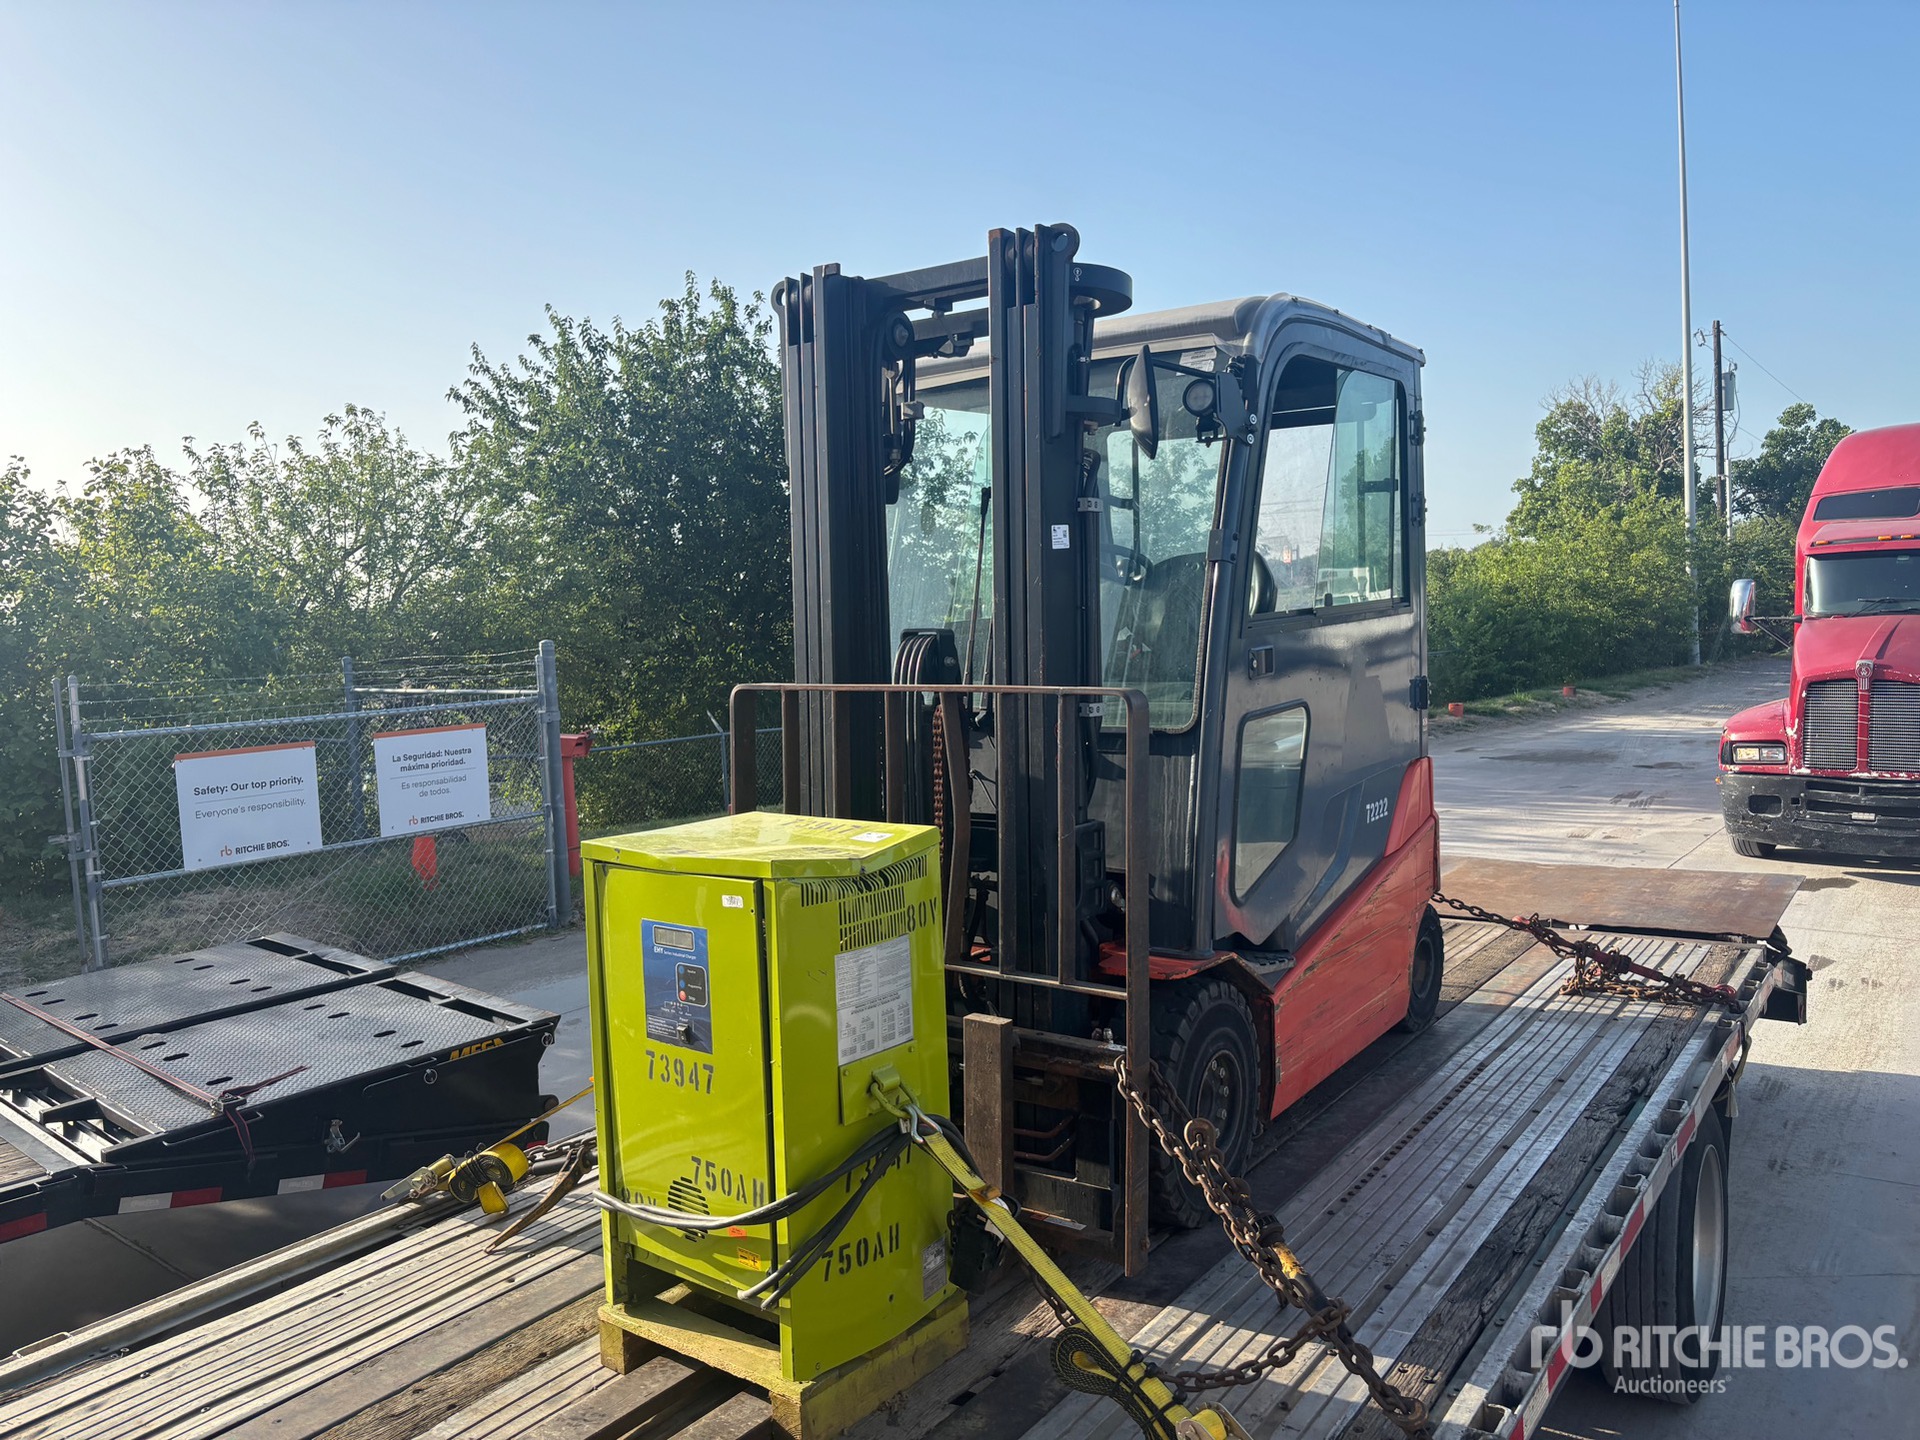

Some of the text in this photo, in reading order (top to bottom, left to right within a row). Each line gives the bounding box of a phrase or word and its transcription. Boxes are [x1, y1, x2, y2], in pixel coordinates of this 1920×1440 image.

[402, 751, 443, 762] Seguridad:
[444, 747, 472, 757] Nuestra
[400, 757, 466, 772] máxima prioridad.
[193, 775, 304, 796] Safety: Our top priority.
[401, 774, 467, 790] Es responsabilidad
[419, 789, 428, 798] de
[247, 798, 306, 812] responsibility.
[420, 814, 444, 824] RITCHIE
[445, 811, 464, 820] BROS.
[220, 840, 290, 857] rb RITCHIE BROS.
[907, 896, 938, 932] 80V
[645, 1050, 714, 1094] 73947
[691, 1156, 765, 1208] 750AH
[821, 1222, 900, 1282] 750AH
